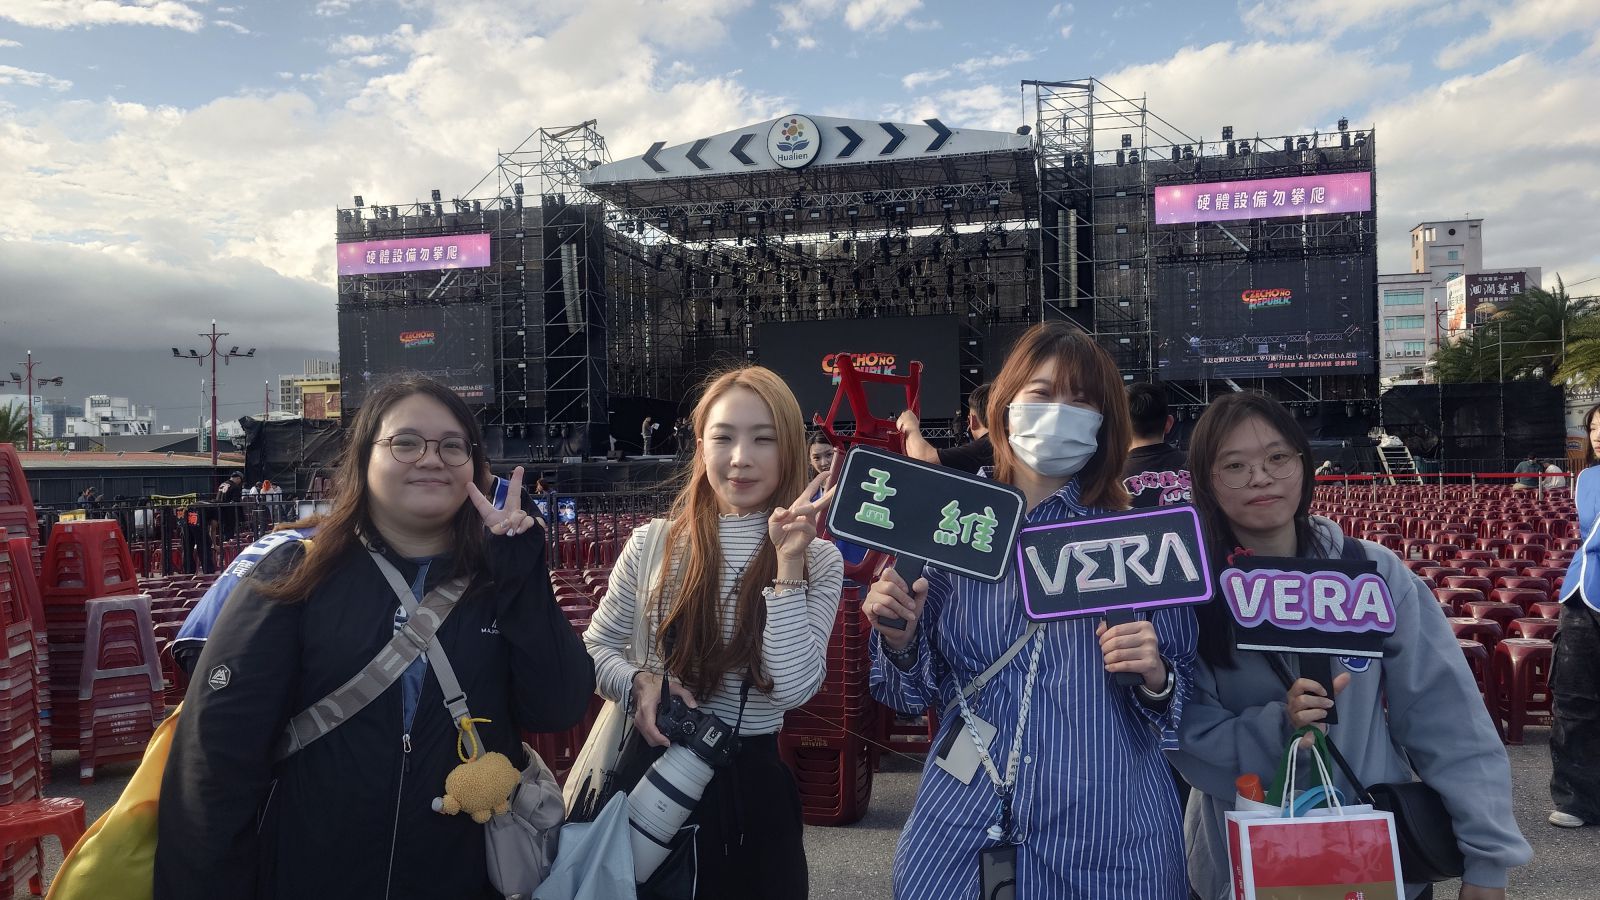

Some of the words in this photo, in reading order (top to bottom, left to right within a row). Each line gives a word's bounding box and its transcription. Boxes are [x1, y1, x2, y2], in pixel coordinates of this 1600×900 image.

[778, 153, 808, 161] Hualien
[1197, 187, 1325, 211] 硬體設備勿攀爬
[366, 245, 458, 264] 硬體設備勿攀爬
[1241, 288, 1280, 302] CZECHO
[1249, 296, 1292, 309] REPUBLIC
[821, 353, 878, 373] CCHO
[879, 356, 895, 366] NO
[1231, 576, 1390, 623] VERA
